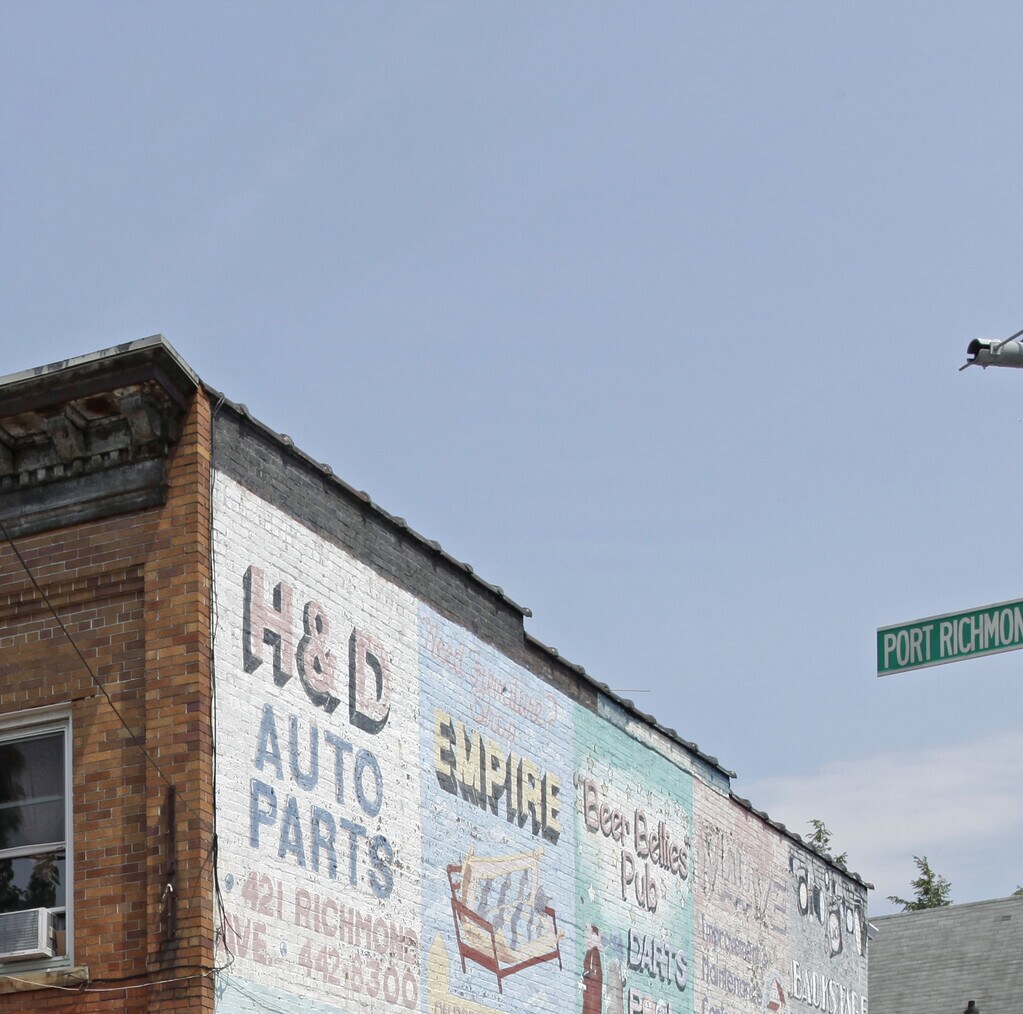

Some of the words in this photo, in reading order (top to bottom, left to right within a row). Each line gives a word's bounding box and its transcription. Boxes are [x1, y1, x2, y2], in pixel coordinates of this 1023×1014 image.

[242, 565, 391, 735] H&D
[884, 625, 933, 668] PORT
[255, 703, 383, 818] AUTO
[434, 709, 561, 845] EMPIRE
[249, 778, 394, 899] PARTS
[621, 850, 657, 913] Pub
[295, 886, 419, 966] RICHMOND
[627, 928, 687, 992] DARTS
